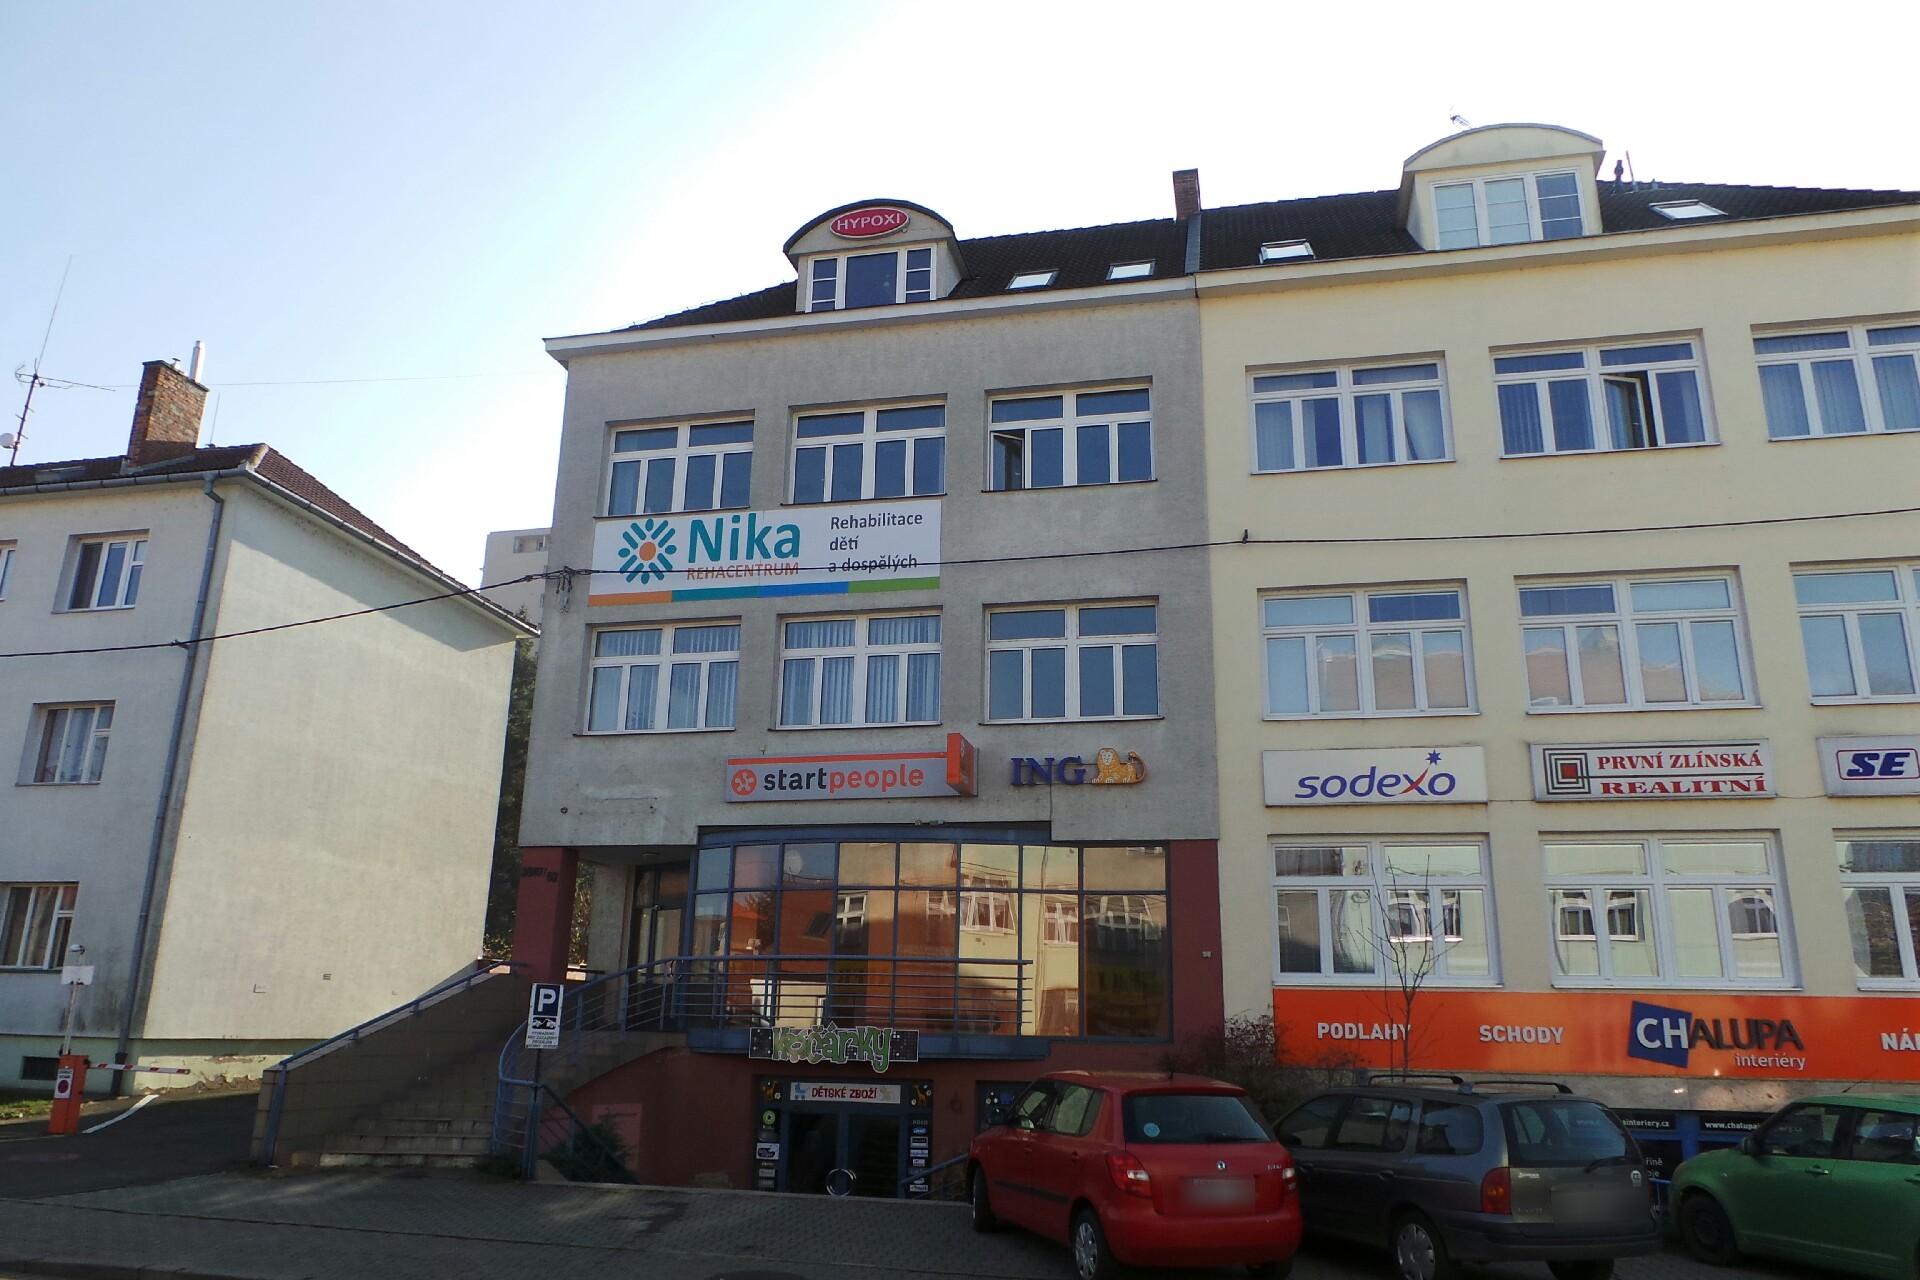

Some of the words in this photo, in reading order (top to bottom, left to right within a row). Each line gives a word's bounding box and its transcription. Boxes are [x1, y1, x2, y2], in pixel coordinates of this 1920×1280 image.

[836, 212, 901, 231] HYPOXI
[830, 512, 923, 530] Rehabilitace
[688, 512, 800, 564] Nika
[829, 535, 858, 551] dětí
[687, 562, 799, 580] REHACENTRUM
[828, 561, 837, 573] a
[841, 554, 917, 574] dospělých
[1596, 751, 1664, 770] PRVNÍ
[1669, 750, 1763, 769] ZLÍNSKÁ
[1846, 752, 1911, 777] SE
[763, 763, 924, 794] startpeople
[1011, 756, 1086, 786] ING
[1294, 766, 1456, 799] sodexo
[1600, 775, 1767, 795] REALITNÍ
[537, 988, 557, 1012] P
[1317, 1022, 1412, 1041] PODLAHY
[1479, 1024, 1564, 1044] SCHODY
[1635, 1017, 1805, 1051] CHALUPA
[1735, 1052, 1806, 1070] interiéry
[811, 1085, 847, 1098] DĚTSKÉ
[849, 1087, 878, 1099] ZBOŽÍ
